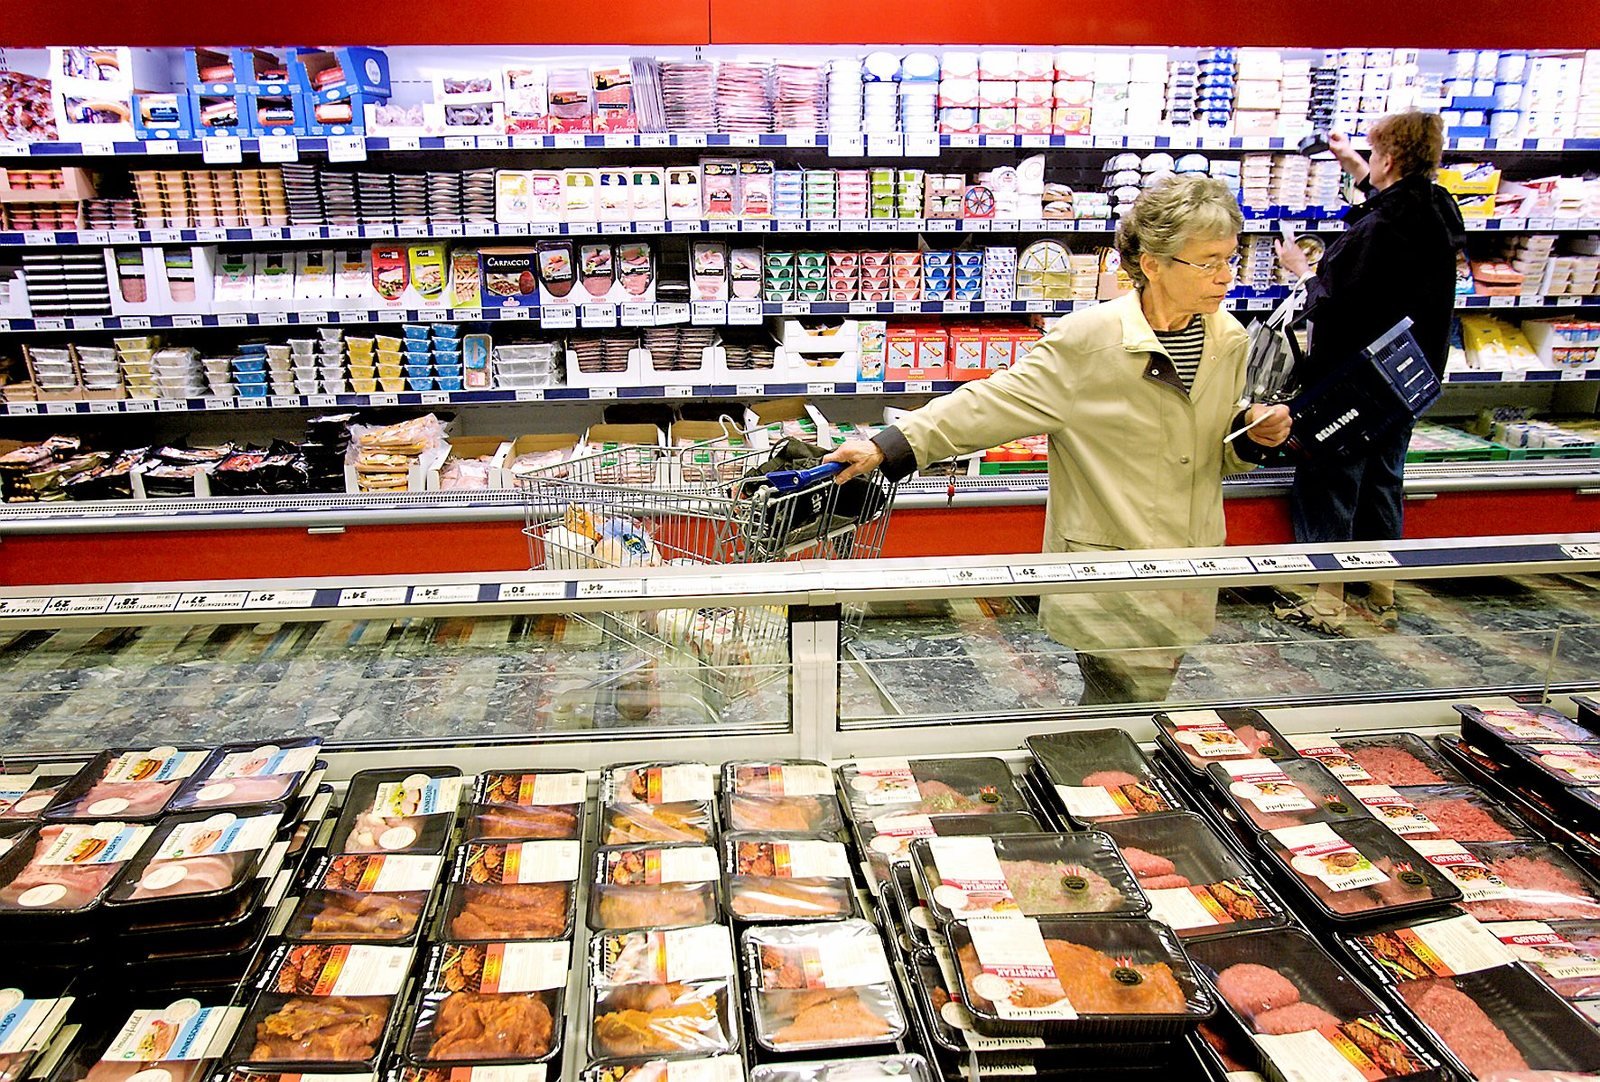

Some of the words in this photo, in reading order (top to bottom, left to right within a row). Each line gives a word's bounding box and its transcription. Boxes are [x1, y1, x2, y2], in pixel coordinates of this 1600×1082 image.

[487, 258, 530, 267] CARPACCIO
[1315, 418, 1342, 442] REMA
[1337, 408, 1360, 427] 1000
[996, 967, 1056, 978] FLANKSTEAK
